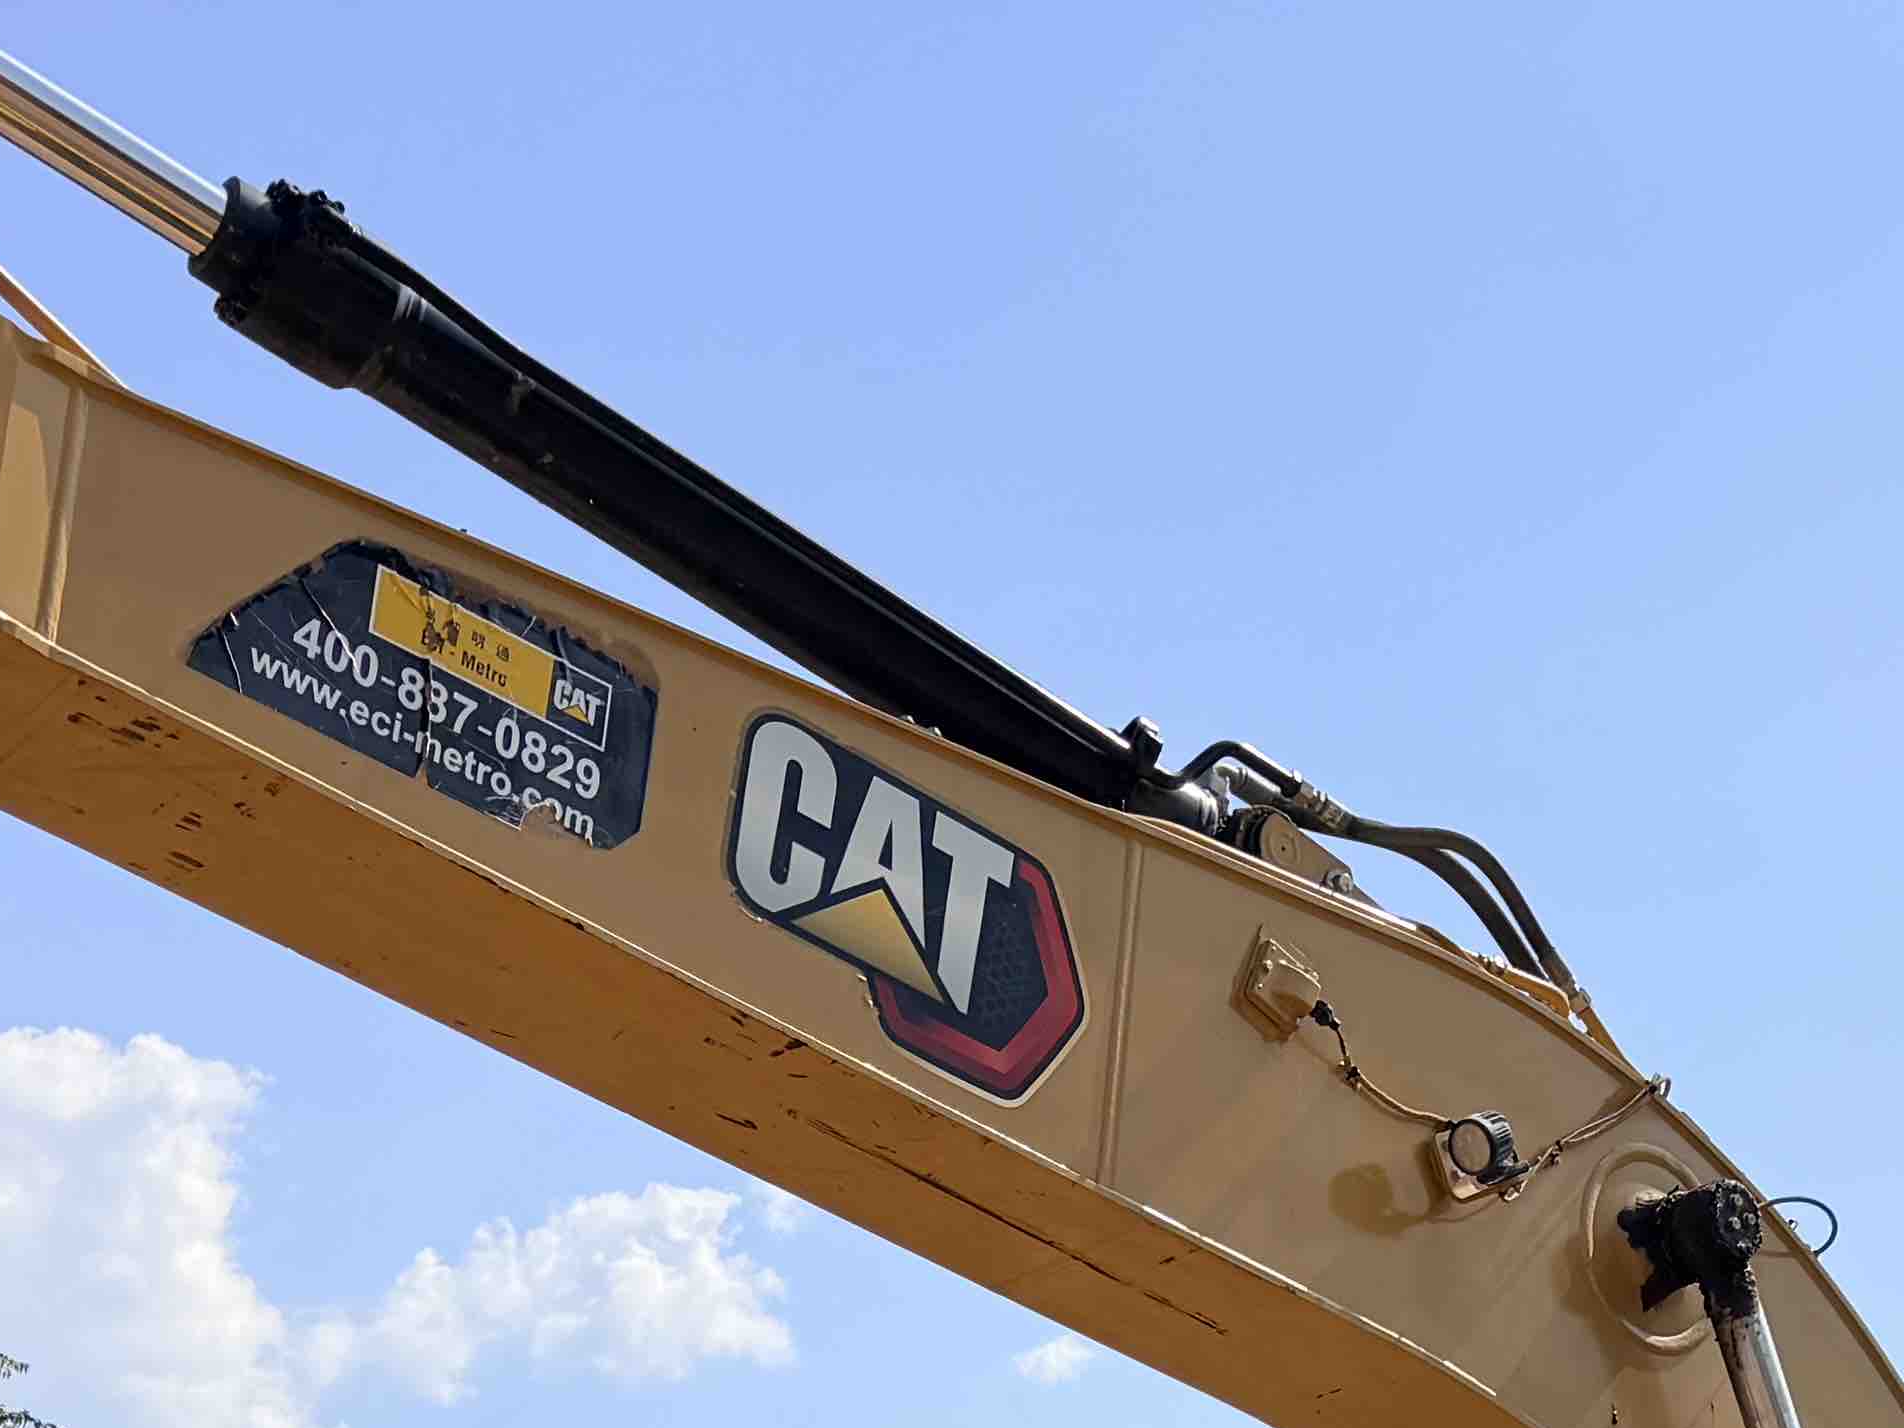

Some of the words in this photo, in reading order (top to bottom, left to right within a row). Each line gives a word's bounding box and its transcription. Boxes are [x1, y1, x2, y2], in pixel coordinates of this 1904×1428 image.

[292, 618, 601, 799] 400-887-0829
[460, 650, 508, 687] Metro
[553, 679, 605, 727] CAT
[735, 720, 1016, 1017] CAT
